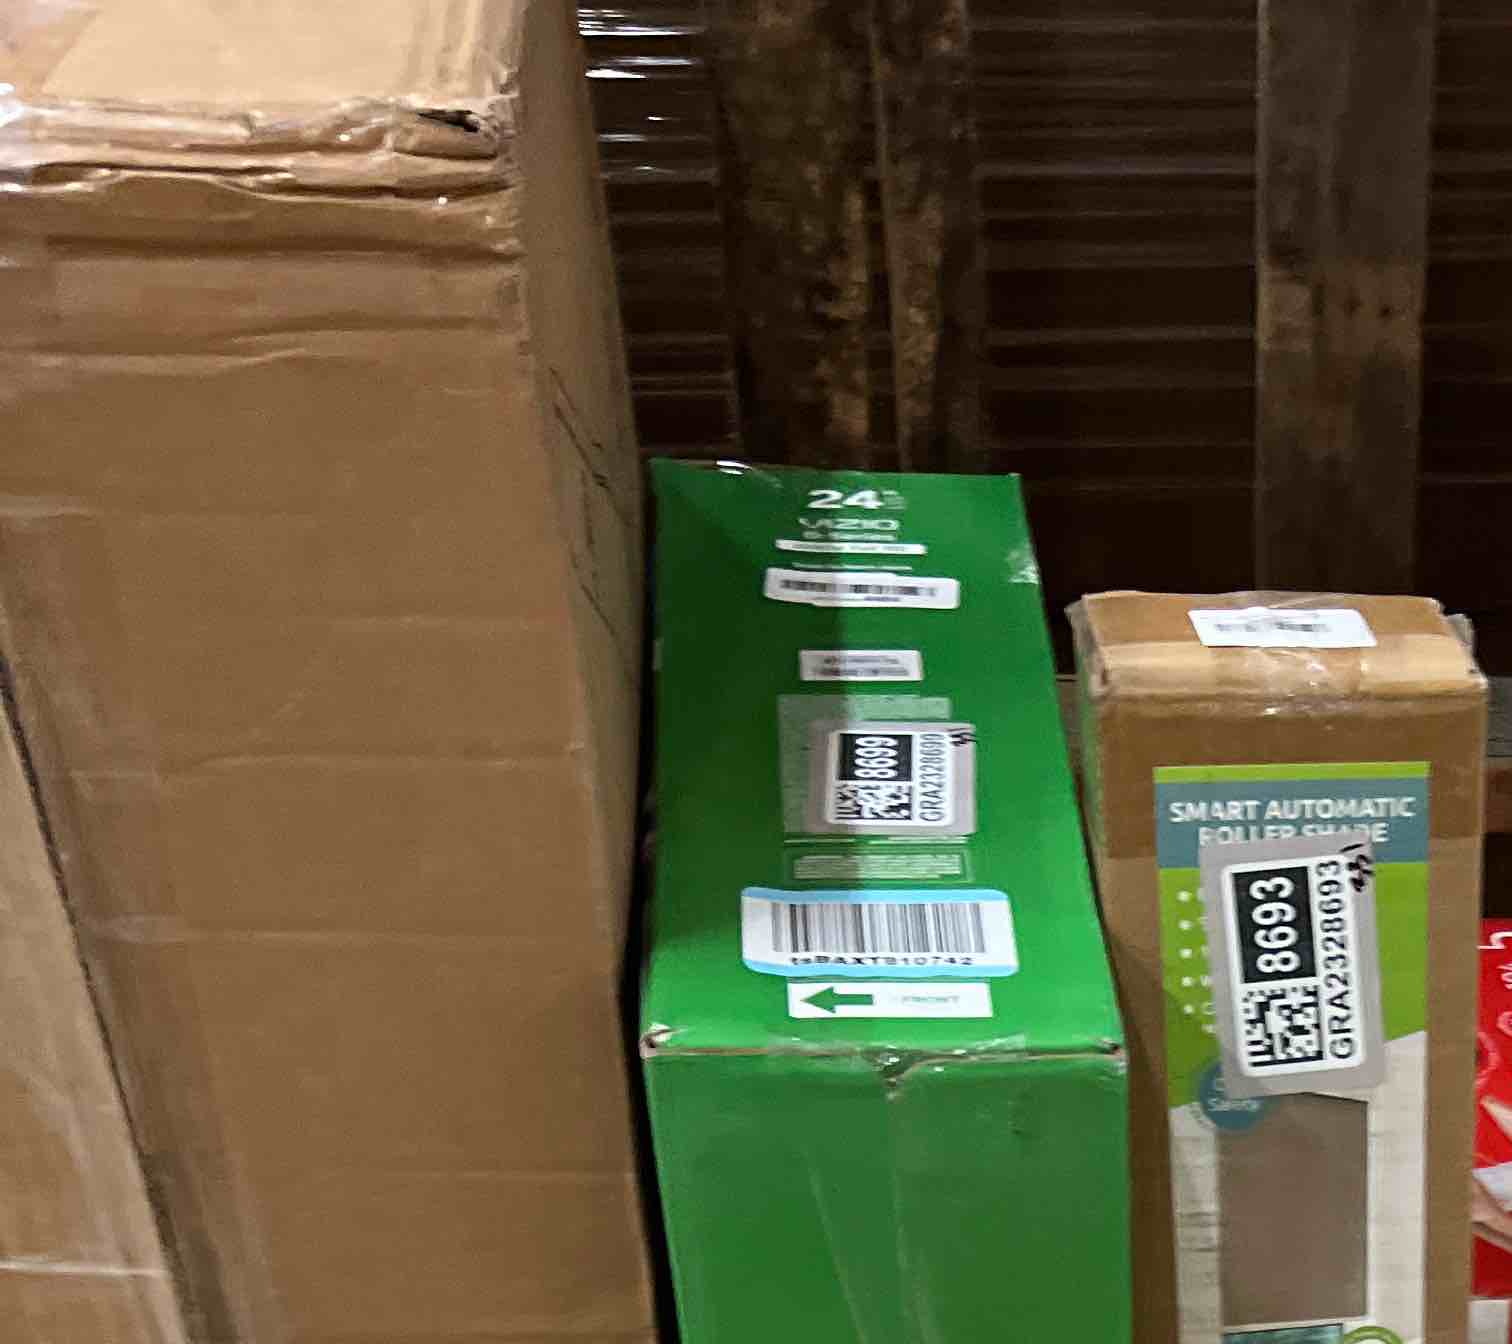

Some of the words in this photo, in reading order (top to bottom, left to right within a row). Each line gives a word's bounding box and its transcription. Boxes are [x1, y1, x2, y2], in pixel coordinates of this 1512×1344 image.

[807, 490, 882, 509] 24
[854, 736, 899, 779] 8699
[1169, 799, 1260, 822] SMART
[1265, 797, 1416, 820] AUTOMATIC
[1249, 875, 1301, 976] 8693
[1315, 860, 1354, 1060] GRA2328693
